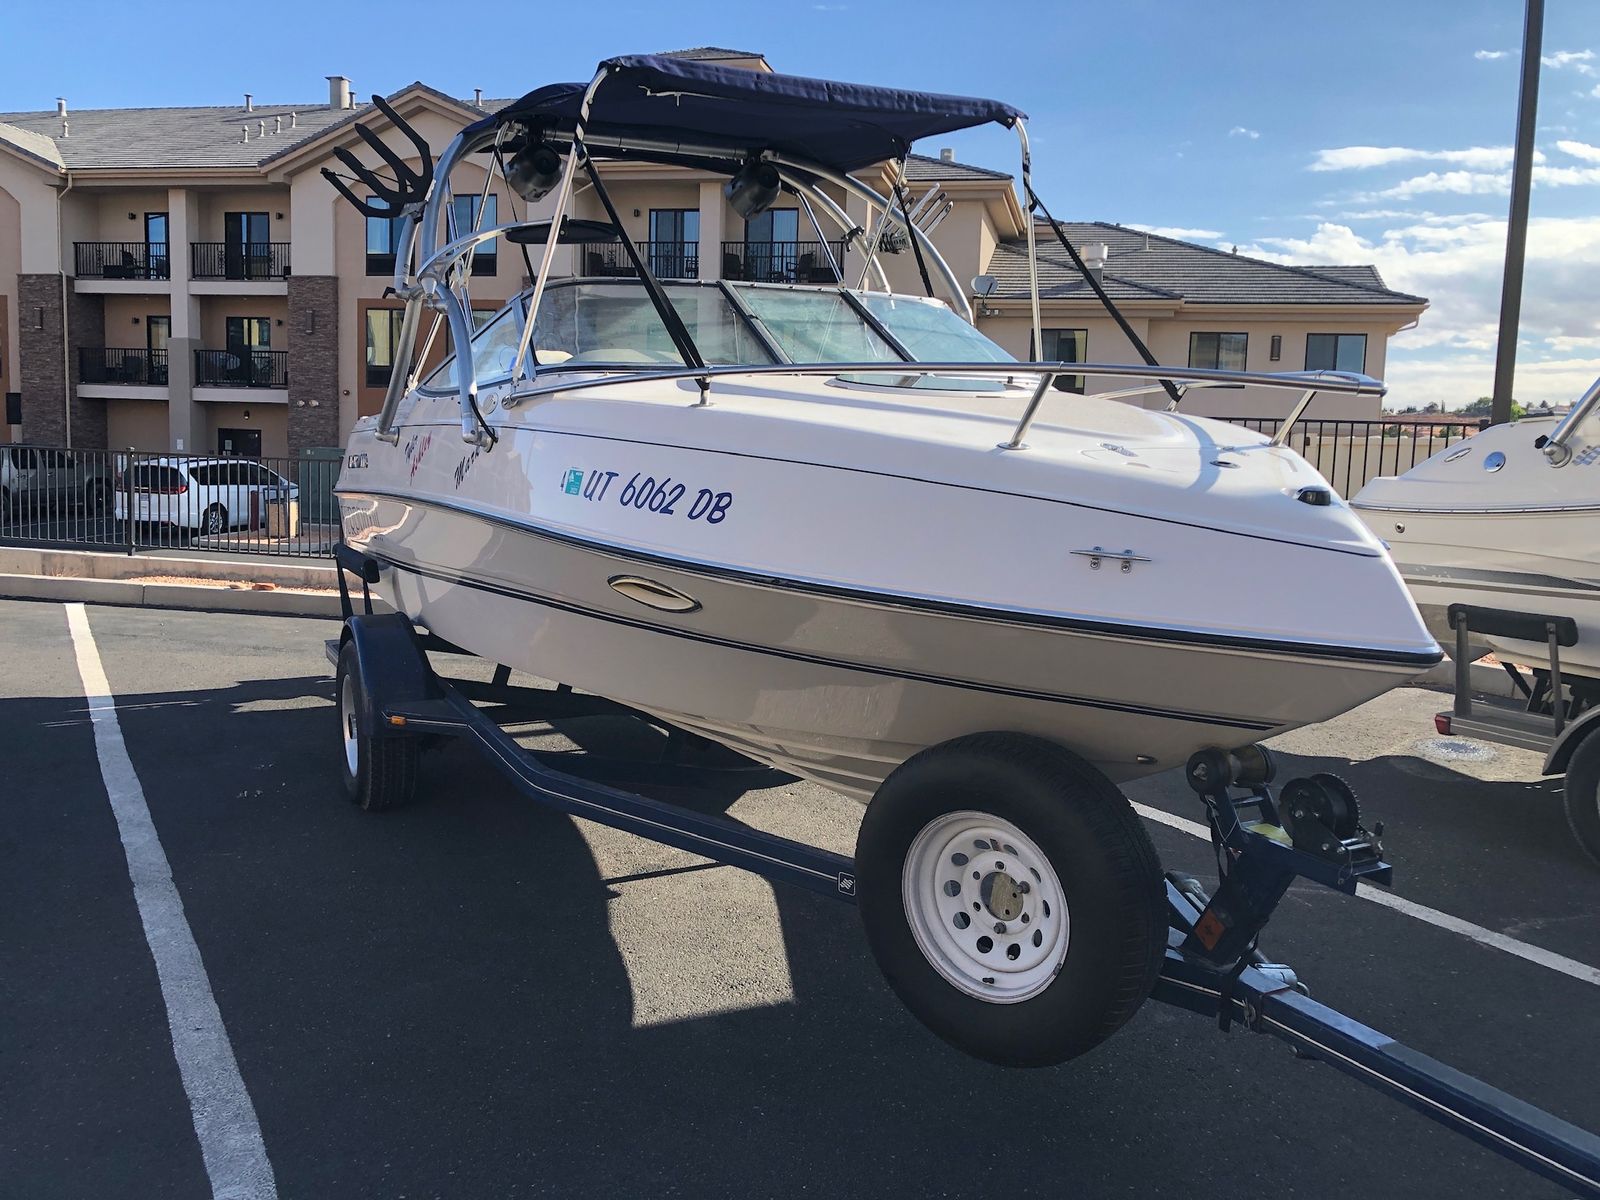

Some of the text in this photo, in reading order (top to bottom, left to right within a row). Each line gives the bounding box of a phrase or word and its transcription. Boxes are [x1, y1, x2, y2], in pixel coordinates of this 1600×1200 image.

[583, 469, 619, 502] UT
[619, 472, 686, 516] 6062
[687, 488, 733, 524] DB
